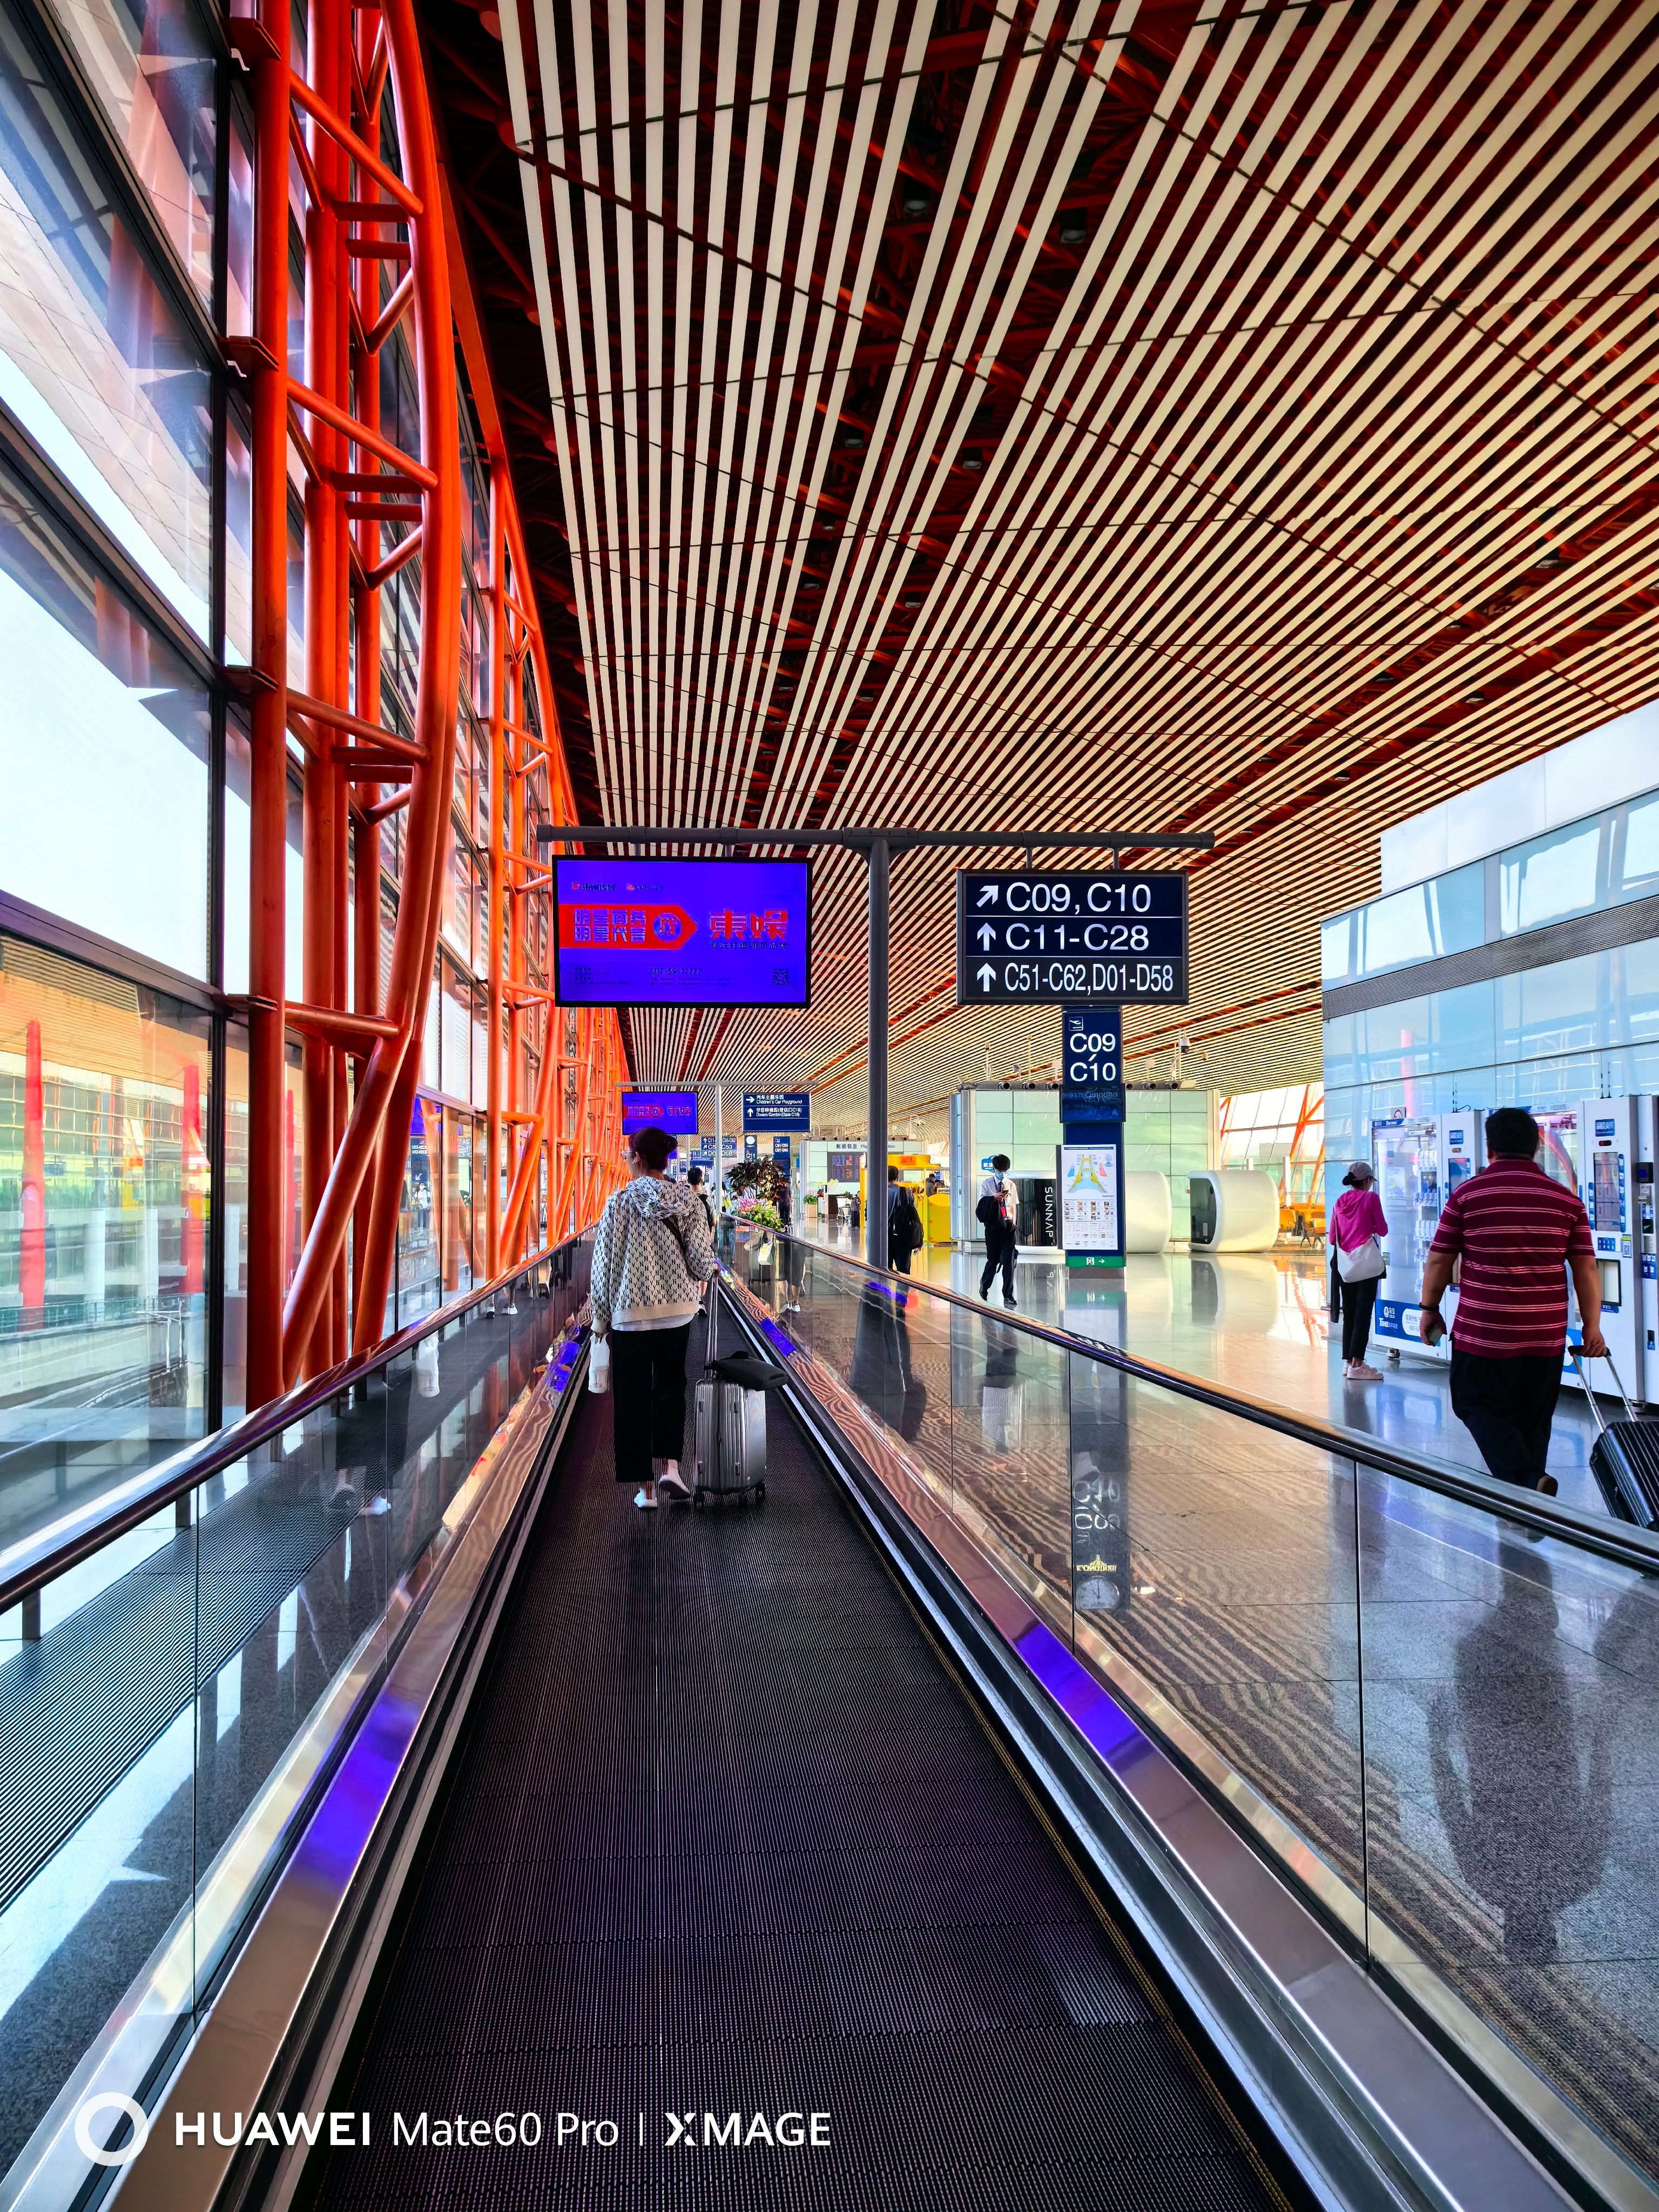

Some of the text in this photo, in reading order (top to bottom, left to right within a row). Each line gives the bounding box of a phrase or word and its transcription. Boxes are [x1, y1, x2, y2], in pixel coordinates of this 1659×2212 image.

[574, 908, 646, 925] 明星商务
[574, 926, 646, 942] 明星代言
[1006, 923, 1149, 950] C11-C28
[1005, 963, 1173, 995] C51-C62,D01-D58
[1070, 1033, 1116, 1053] C09
[1070, 1062, 1116, 1082] C10
[1044, 1186, 1054, 1237] SUNNAP
